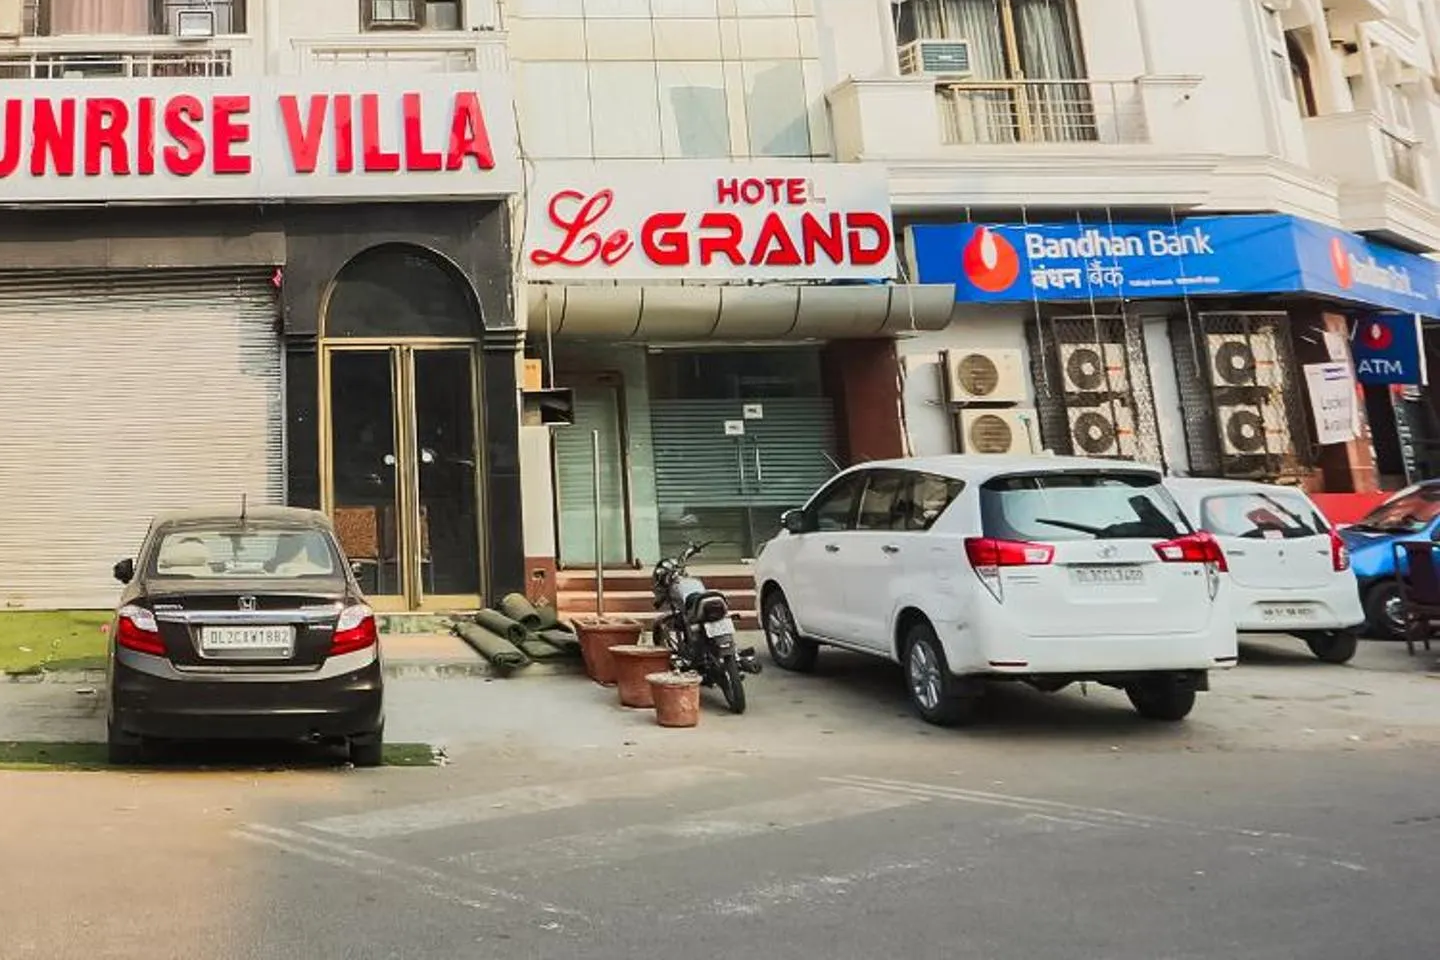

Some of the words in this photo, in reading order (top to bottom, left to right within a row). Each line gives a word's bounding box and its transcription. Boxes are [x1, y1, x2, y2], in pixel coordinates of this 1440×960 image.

[279, 91, 496, 173] VILLA
[717, 177, 826, 205] HOTEL
[530, 188, 635, 266] Le
[641, 211, 891, 266] GRAND
[1025, 230, 1144, 258] Bandhan
[1148, 227, 1214, 256] Bank
[1358, 358, 1403, 375] ATM
